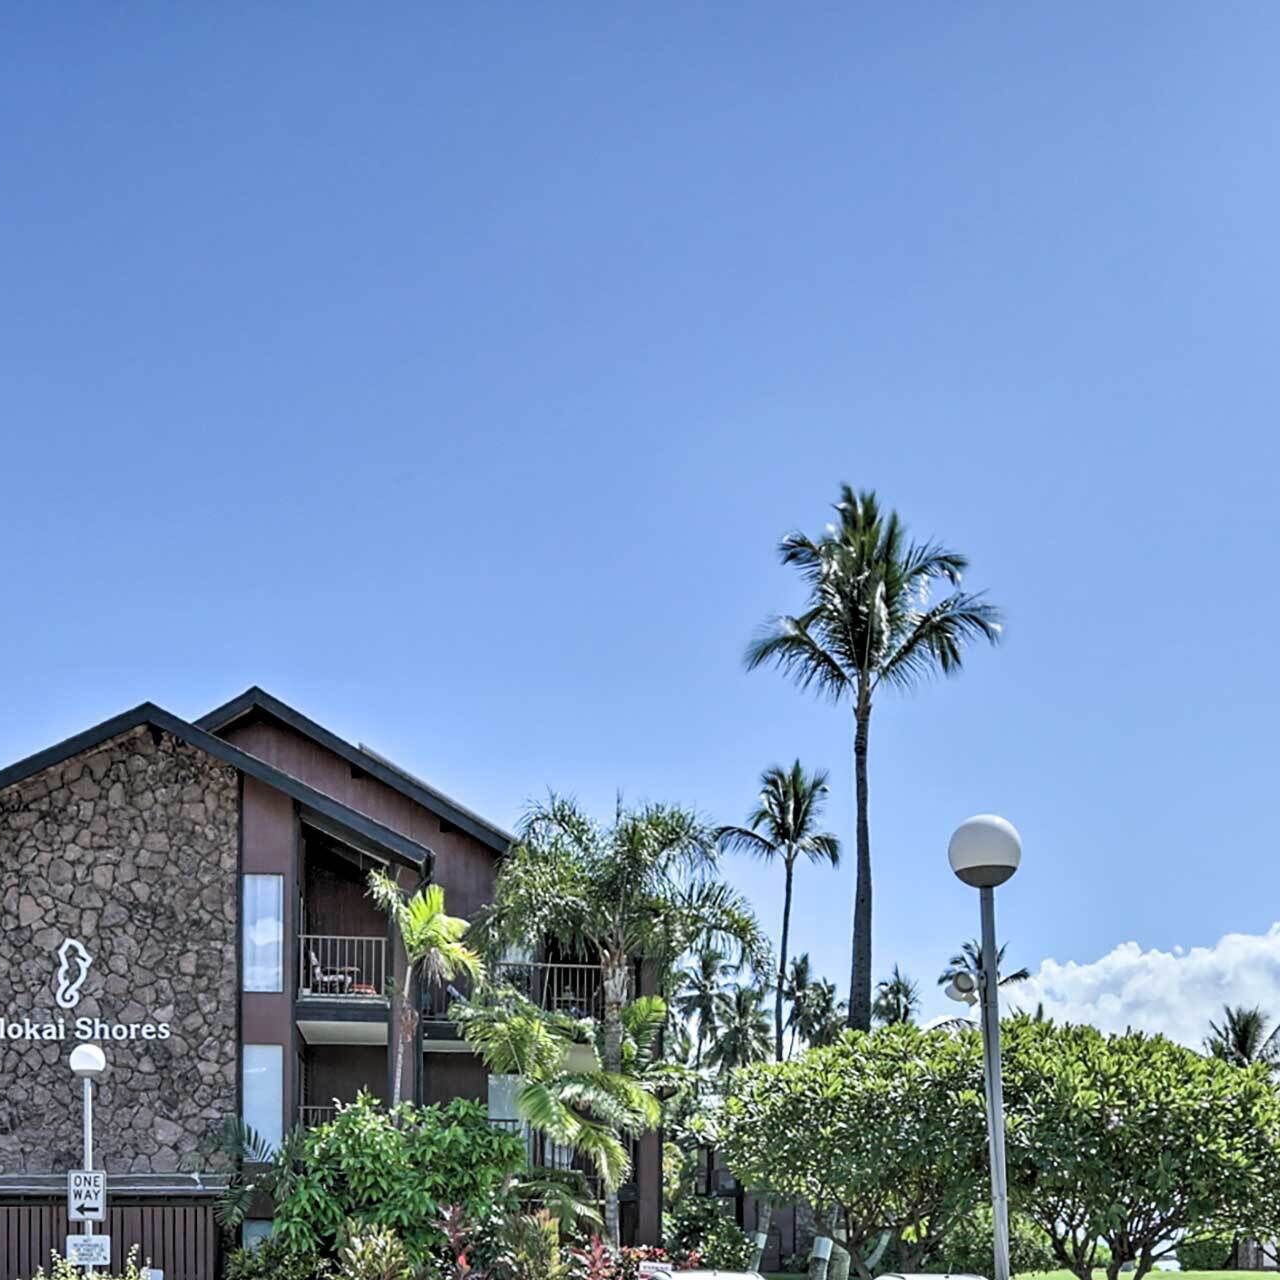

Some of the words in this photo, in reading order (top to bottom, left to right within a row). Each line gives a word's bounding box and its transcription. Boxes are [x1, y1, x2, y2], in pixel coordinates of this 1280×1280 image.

[74, 1017, 171, 1040] Shores
[73, 1175, 101, 1188] ONE
[72, 1189, 102, 1200] WAY
